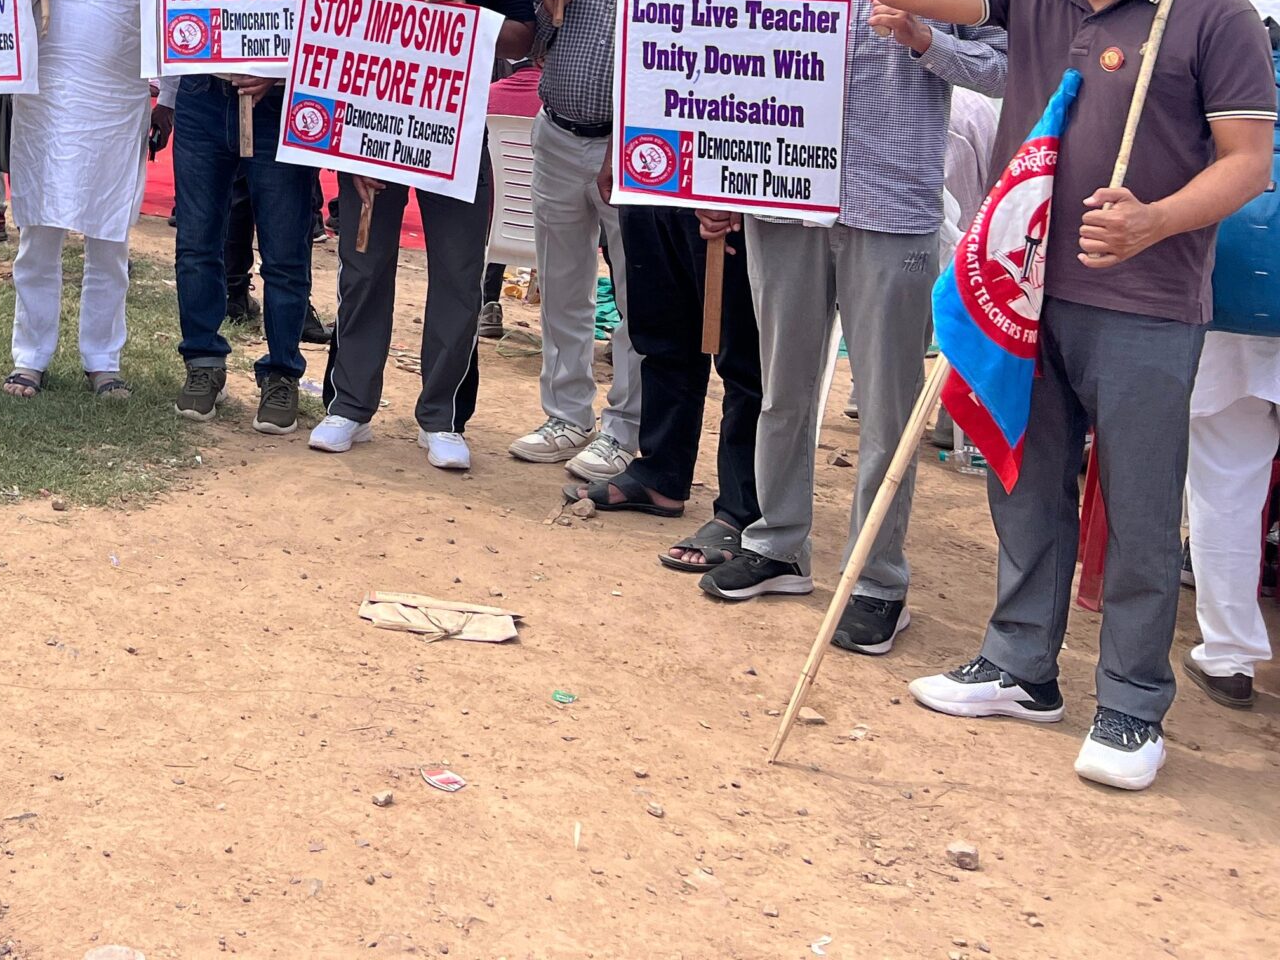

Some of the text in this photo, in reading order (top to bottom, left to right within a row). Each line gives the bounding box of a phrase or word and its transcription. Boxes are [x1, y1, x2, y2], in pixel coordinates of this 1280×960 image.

[222, 9, 279, 31] DEMOCRATIC
[363, 0, 467, 57] IMPOSING
[745, 0, 840, 33] Teacher
[241, 35, 270, 57] FRONT
[704, 45, 766, 77] Down
[773, 49, 825, 81] With
[299, 43, 339, 90] TET
[338, 51, 420, 106] BEFORE
[420, 66, 465, 114] RTE
[345, 103, 404, 136] DEMOCRATIC
[407, 115, 456, 146] TEACHERS
[664, 89, 805, 128] Privatisation
[359, 133, 432, 168] FRONT PUNJAB
[697, 131, 771, 165] DEMOCRATIC
[776, 138, 837, 170] TEACHERS
[720, 165, 811, 201] FRONT PUNJAB
[974, 286, 1021, 340] TEACHERS
[1023, 329, 1038, 344] FRO
